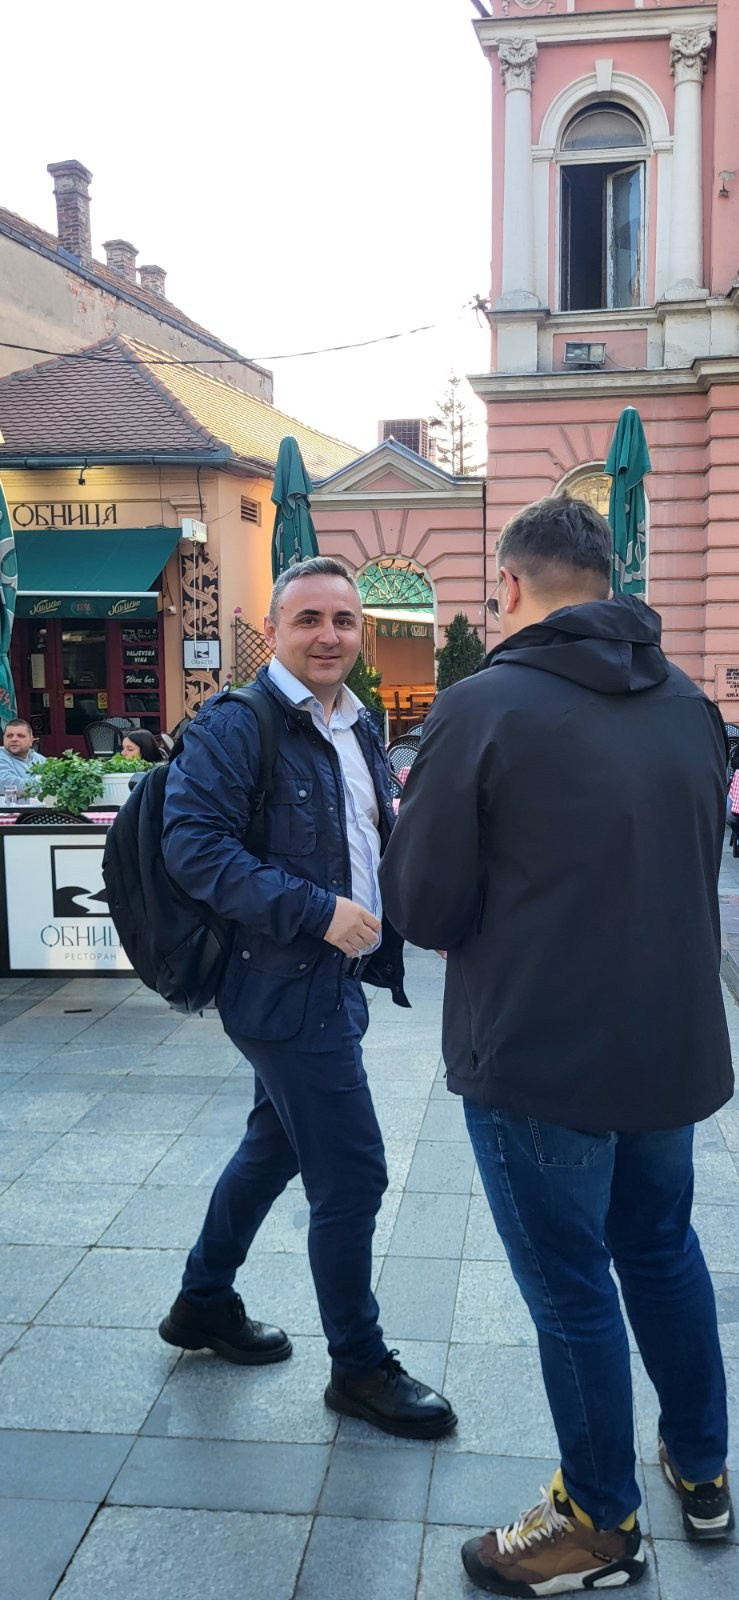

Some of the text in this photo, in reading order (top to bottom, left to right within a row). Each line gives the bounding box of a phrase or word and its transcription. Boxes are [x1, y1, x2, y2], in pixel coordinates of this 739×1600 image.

[13, 503, 118, 528] ОБНИЦА
[40, 924, 122, 948] ОБНИЦ
[64, 952, 117, 961] РЕСТОРАН
